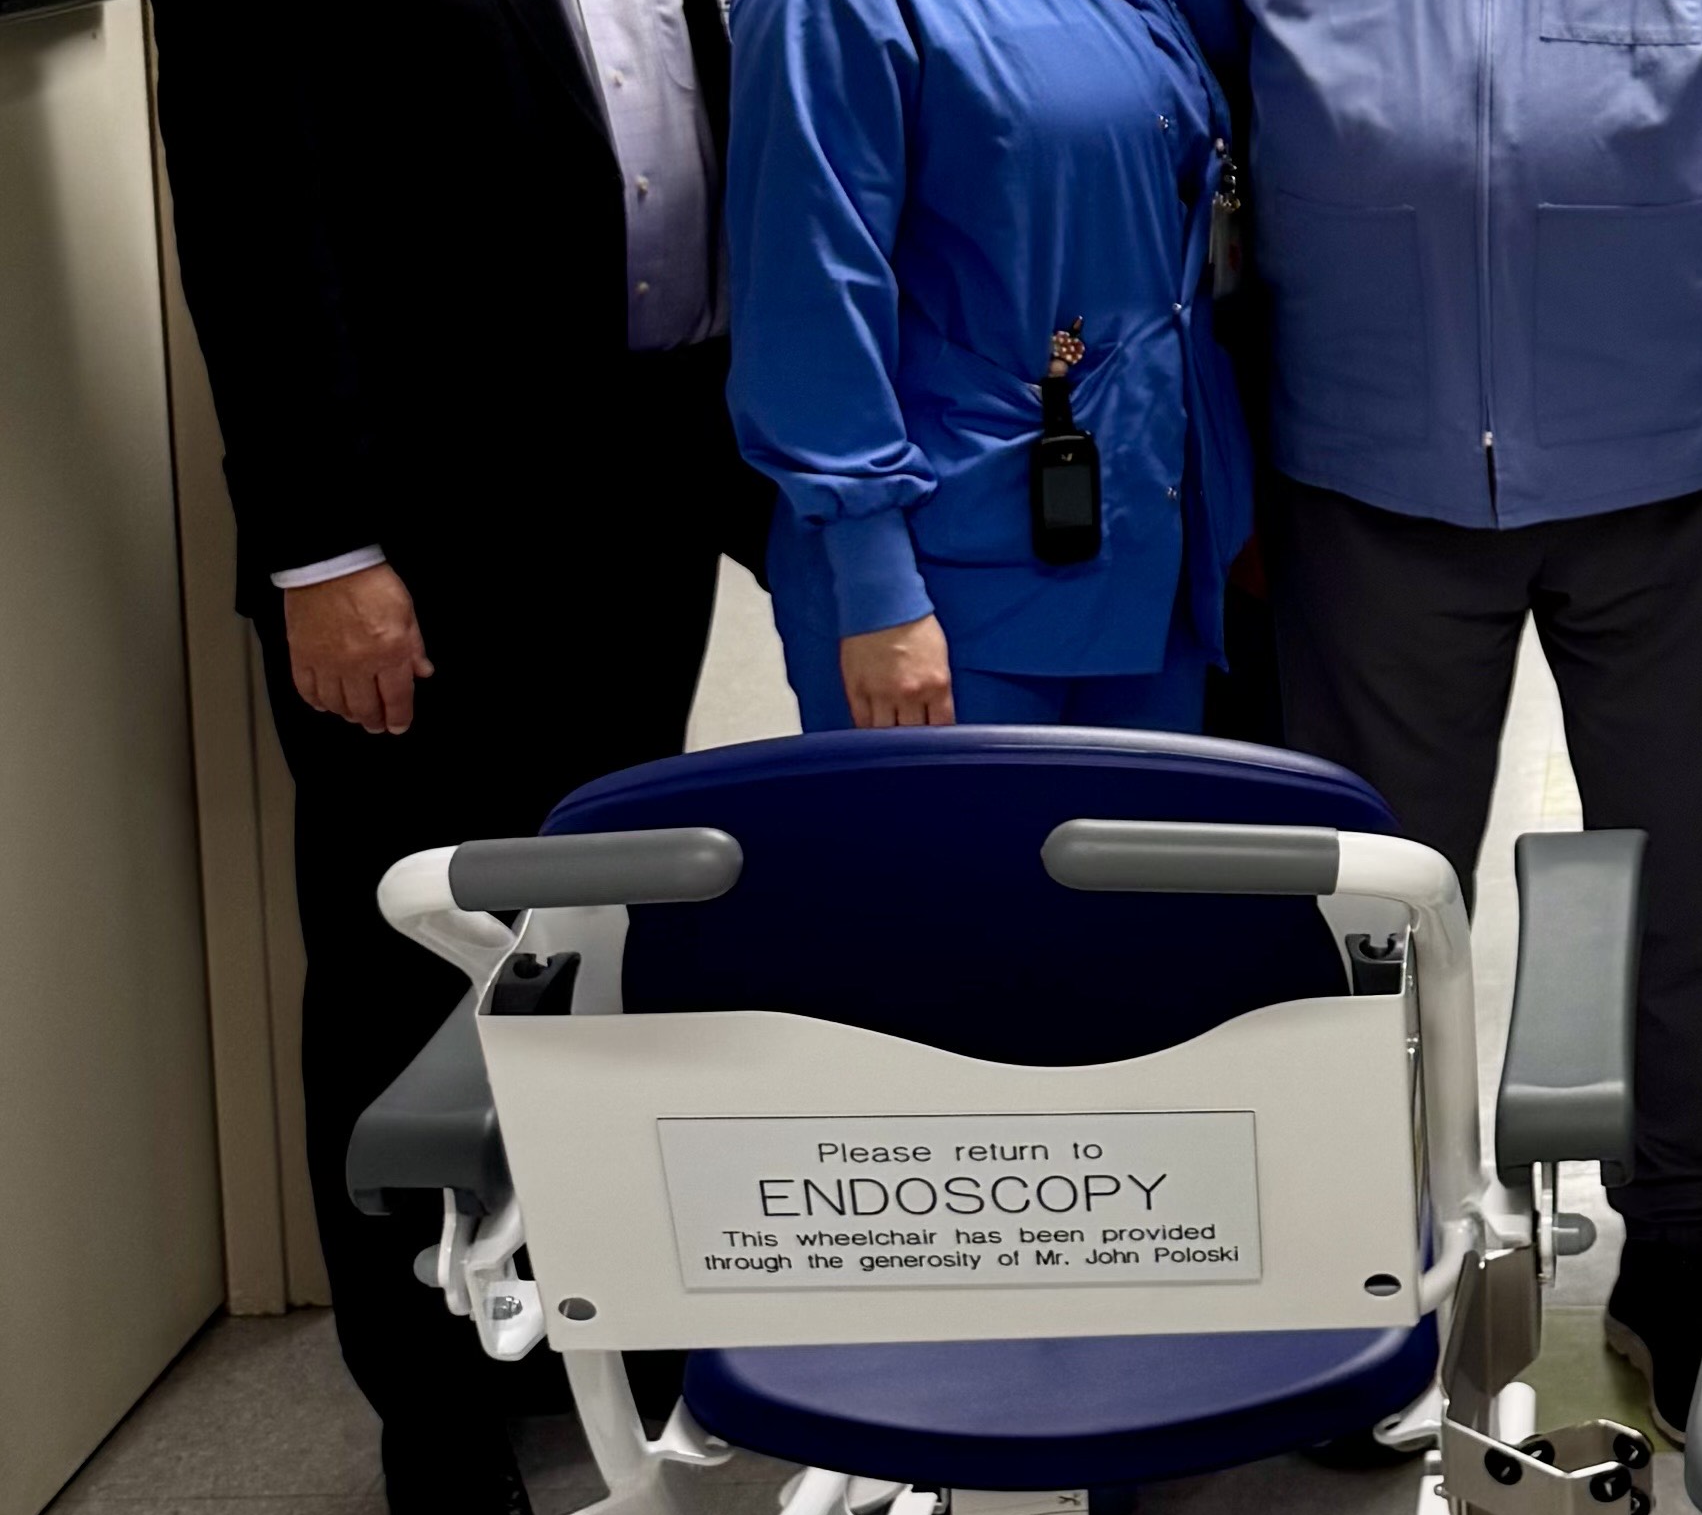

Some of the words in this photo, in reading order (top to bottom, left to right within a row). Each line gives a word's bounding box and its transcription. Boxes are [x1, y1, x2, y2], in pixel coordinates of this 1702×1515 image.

[818, 1142, 932, 1163] Please
[955, 1142, 1049, 1162] return
[1073, 1142, 1103, 1160] to
[758, 1173, 1167, 1217] ENDOSCOPY
[722, 1230, 778, 1247] This
[796, 1228, 938, 1246] wheelchair
[955, 1228, 1002, 1244] has
[1019, 1227, 1085, 1243] been
[1102, 1223, 1216, 1244] provided
[704, 1254, 792, 1273] through
[808, 1253, 843, 1268] the
[859, 1250, 981, 1272] generosity
[998, 1250, 1019, 1267] of
[1036, 1249, 1070, 1266] Mr.
[1085, 1248, 1140, 1265] John
[1154, 1246, 1239, 1263] Poloski
